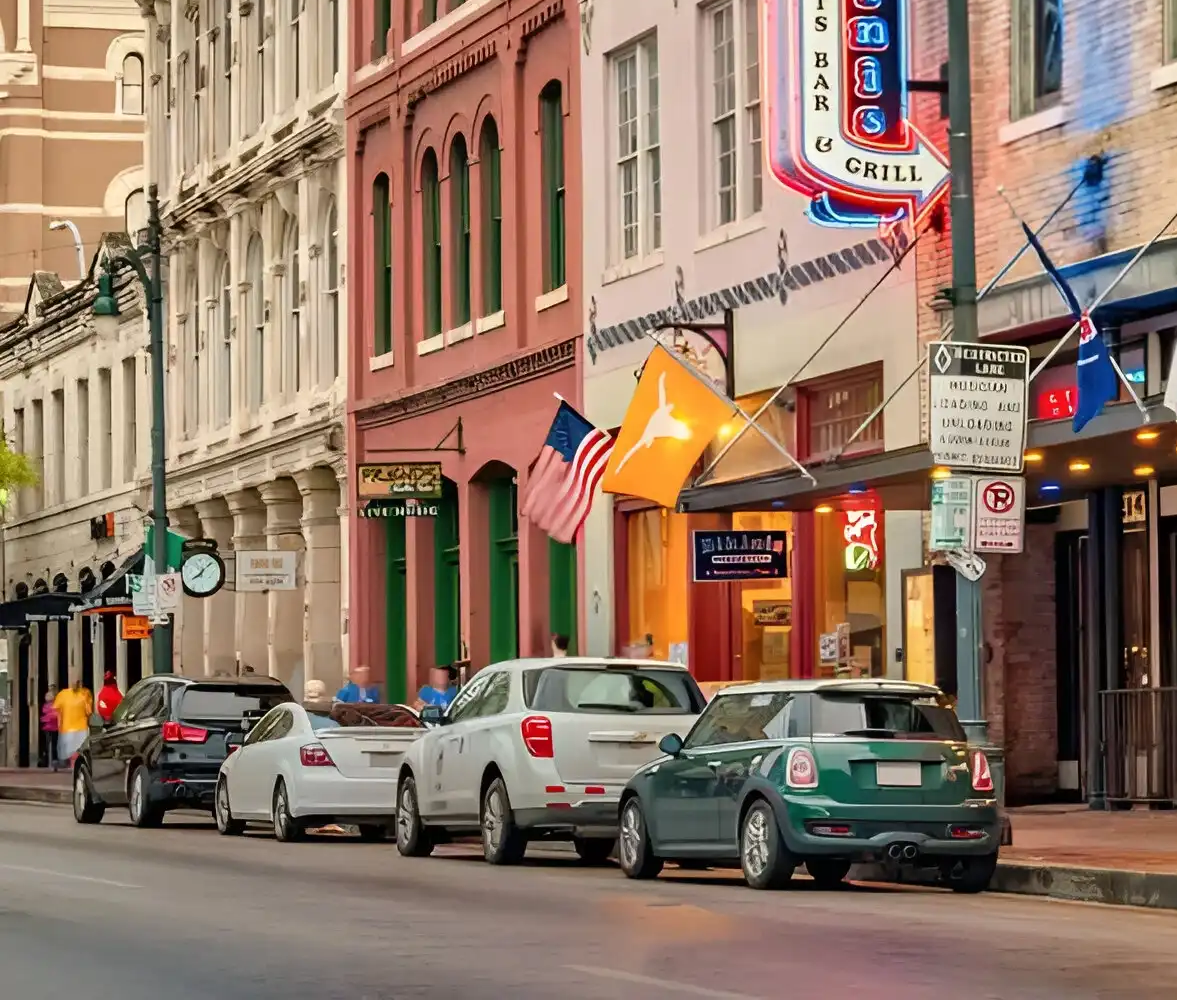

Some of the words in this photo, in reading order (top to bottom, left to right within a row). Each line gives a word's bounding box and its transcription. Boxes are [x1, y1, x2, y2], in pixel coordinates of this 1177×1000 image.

[813, 52, 830, 112] BAR
[815, 136, 833, 153] &
[845, 156, 923, 183] GRILL
